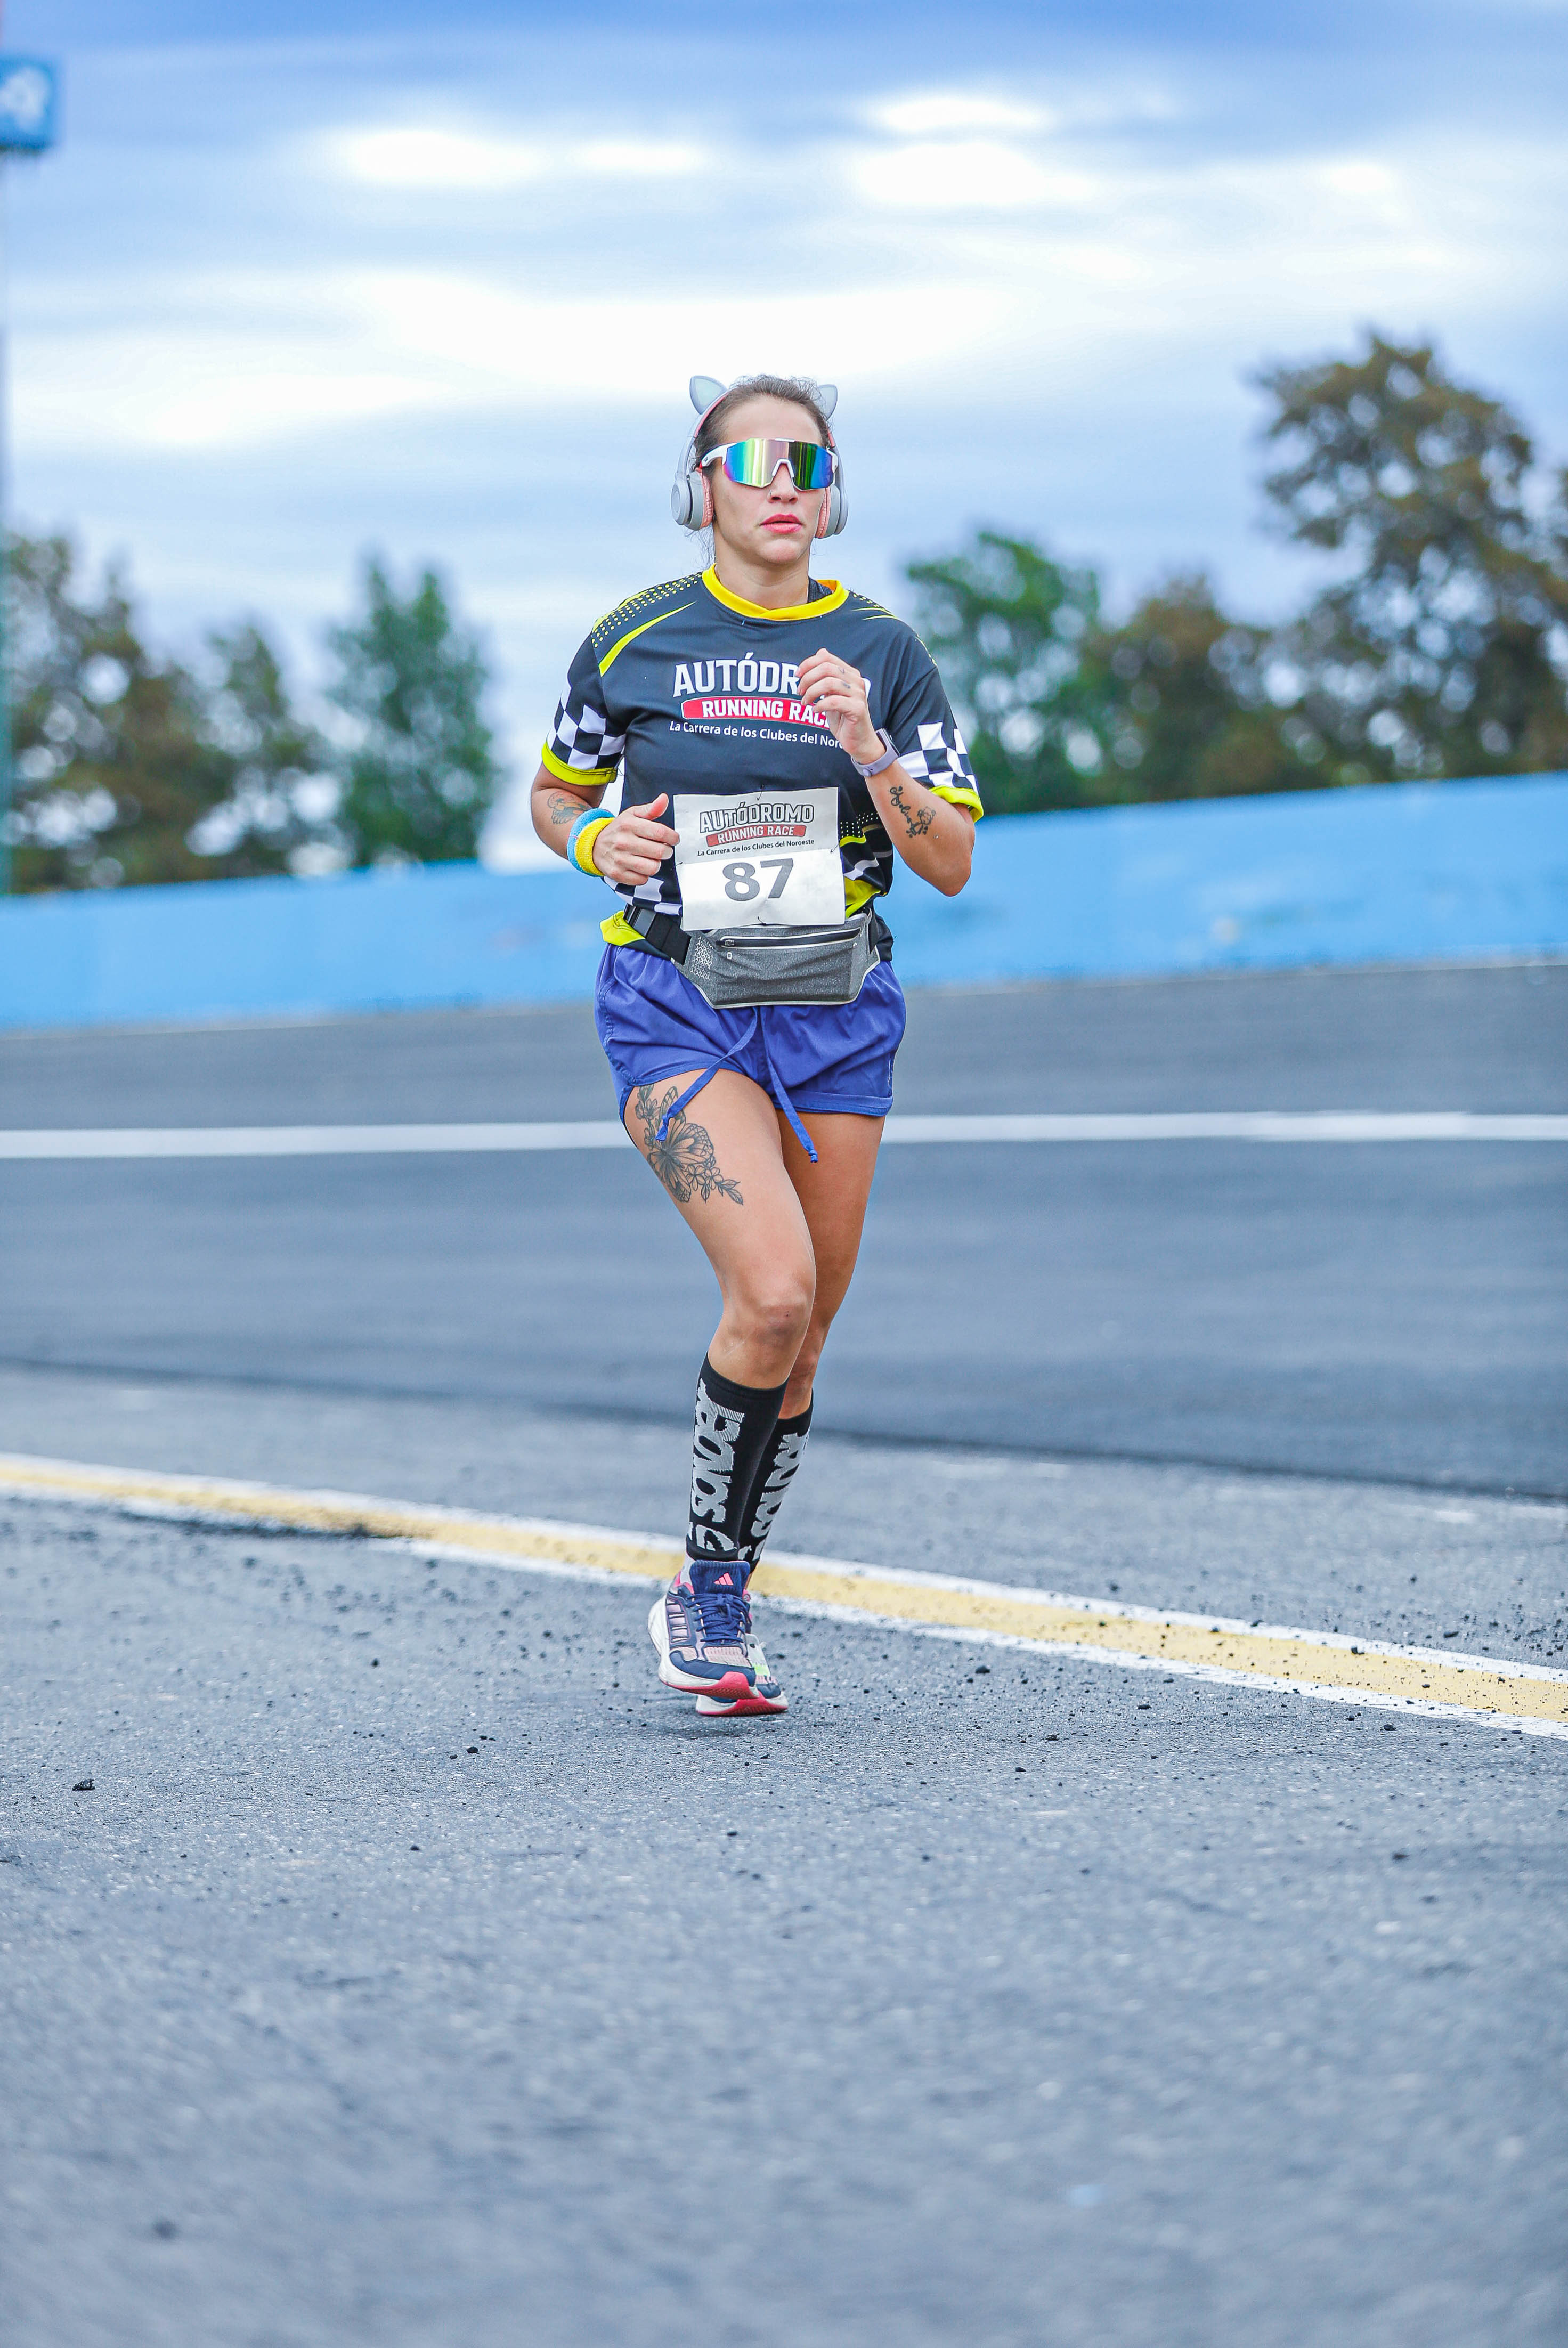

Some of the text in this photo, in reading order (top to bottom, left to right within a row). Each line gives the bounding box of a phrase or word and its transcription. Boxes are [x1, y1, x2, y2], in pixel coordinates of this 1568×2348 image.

[672, 652, 871, 699] AUTÓDR
[702, 698, 830, 728] RUNNING RAC
[669, 721, 681, 732] La
[683, 722, 721, 735] Carrera
[724, 724, 738, 736] de
[740, 726, 757, 738] los
[759, 728, 798, 742] Clubes
[800, 732, 817, 745] del
[700, 801, 814, 833] AUTÓDROMO
[717, 825, 795, 844] RUNNING RACE
[786, 839, 815, 847] Noroeste
[722, 858, 794, 901] 87
